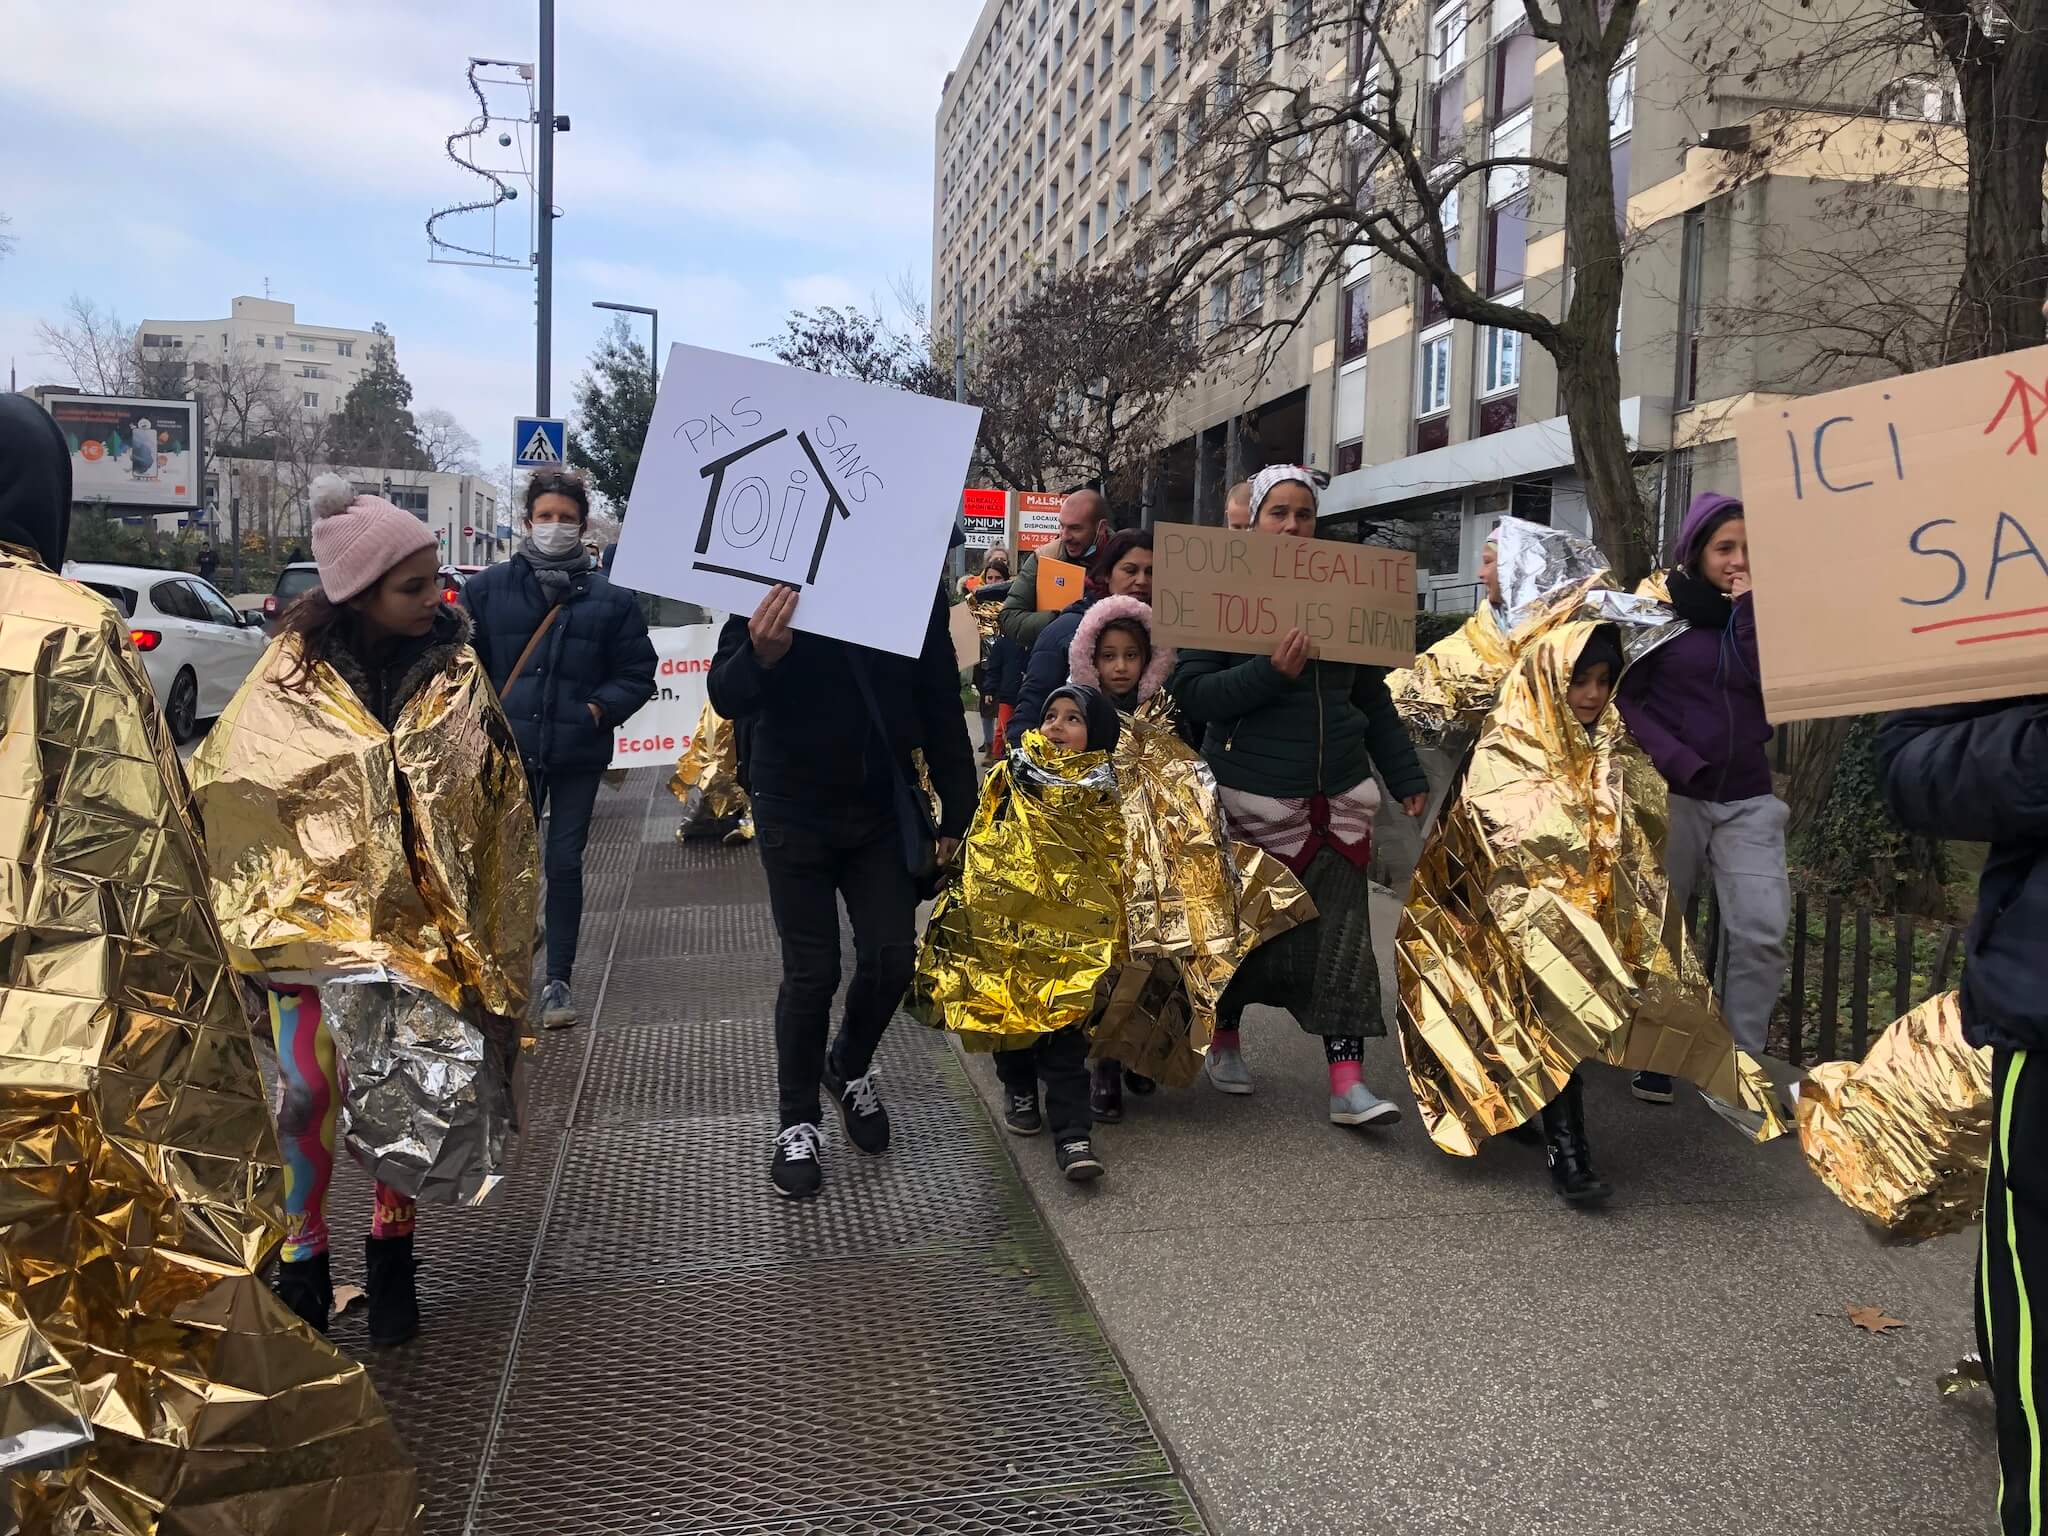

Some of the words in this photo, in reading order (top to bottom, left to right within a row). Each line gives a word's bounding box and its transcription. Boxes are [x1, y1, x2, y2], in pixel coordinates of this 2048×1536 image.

[673, 396, 762, 454] PAS
[815, 415, 884, 503] SANS
[1163, 533, 1252, 575] POUR
[1158, 588, 1198, 628] DE
[1213, 592, 1279, 635] TOUS
[661, 658, 712, 676] dans
[618, 735, 675, 753] Ecole
